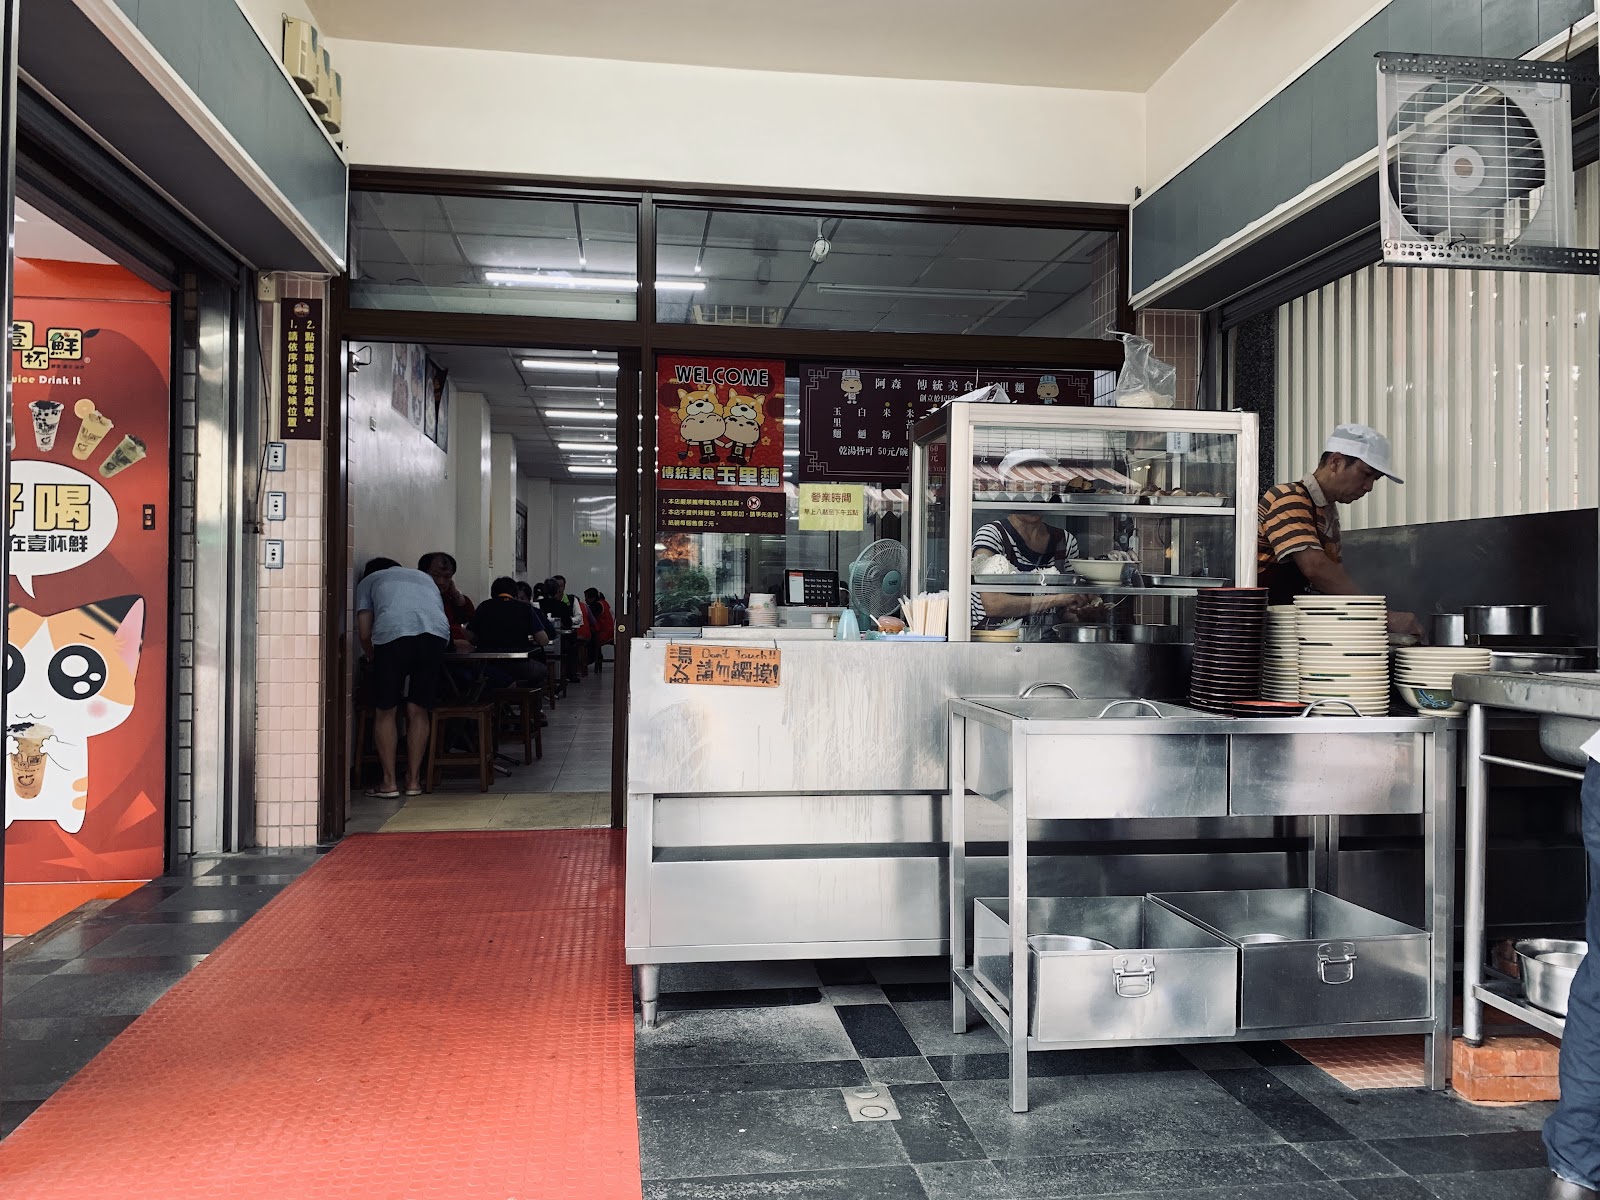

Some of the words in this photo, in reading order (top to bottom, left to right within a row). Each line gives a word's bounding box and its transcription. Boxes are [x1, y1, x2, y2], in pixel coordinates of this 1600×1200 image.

[39, 375, 70, 385] Drink
[73, 376, 82, 385] It
[675, 365, 769, 387] WELCOME
[875, 378, 902, 390] 阿森
[917, 379, 974, 392] 傳統美食
[832, 406, 842, 439] 玉里麵
[882, 408, 891, 440] 米粉
[661, 466, 715, 481] 傳統美食
[716, 466, 780, 487] 玉里麵
[10, 483, 91, 531] 喝
[811, 492, 852, 503] 營業時間
[804, 508, 859, 516] 早上八點至下午五點
[10, 534, 88, 552] 在壹杯鮮
